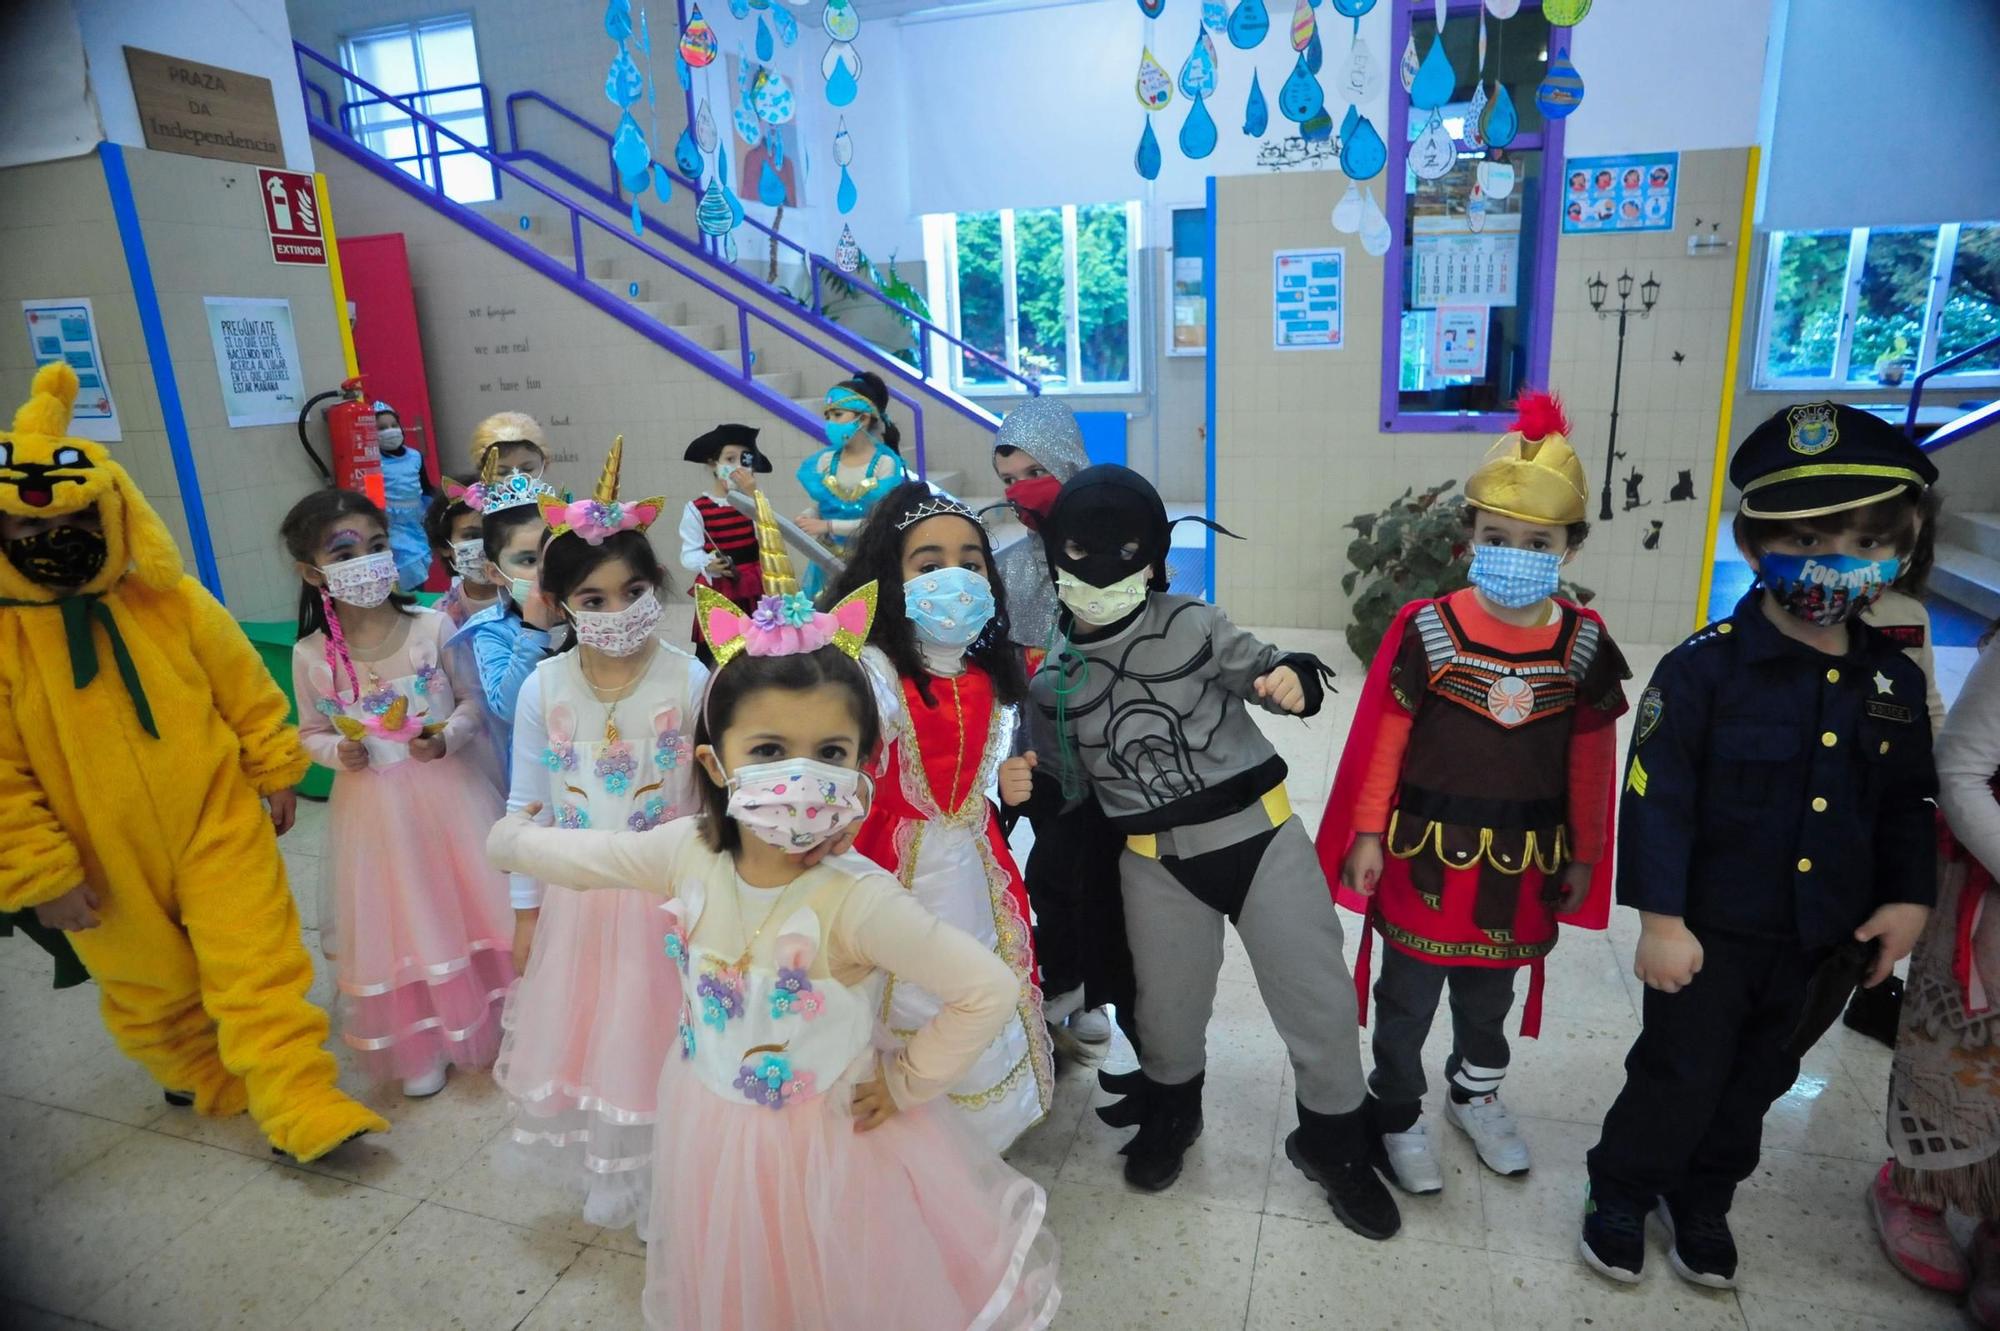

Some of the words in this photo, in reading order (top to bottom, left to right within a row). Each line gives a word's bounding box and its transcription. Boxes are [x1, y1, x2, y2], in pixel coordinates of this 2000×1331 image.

[168, 66, 227, 92] PRAZA
[189, 100, 212, 116] DA
[150, 118, 277, 153] Independencia
[276, 244, 322, 256] EXTINTOR
[221, 317, 276, 336] PREGÚNTATE
[234, 336, 243, 348] LO
[244, 336, 258, 348] QUE
[474, 346, 488, 355] we
[496, 344, 509, 354] are
[513, 336, 530, 352] real
[226, 348, 260, 360] HACIENDO
[262, 348, 274, 359] HOY
[230, 360, 256, 371] ACERCA
[257, 360, 266, 371] AL
[266, 359, 288, 370] LUGAR
[230, 371, 240, 382] EN
[250, 371, 262, 381] QUE
[480, 383, 492, 392] we
[500, 376, 519, 392] have
[526, 376, 541, 390] fun
[232, 382, 253, 393] ESTAR
[254, 380, 280, 392] MAÑANA
[1793, 406, 1831, 421] POLICE
[1799, 559, 1882, 589] FORTNITE
[1871, 704, 1905, 719] POLICE
